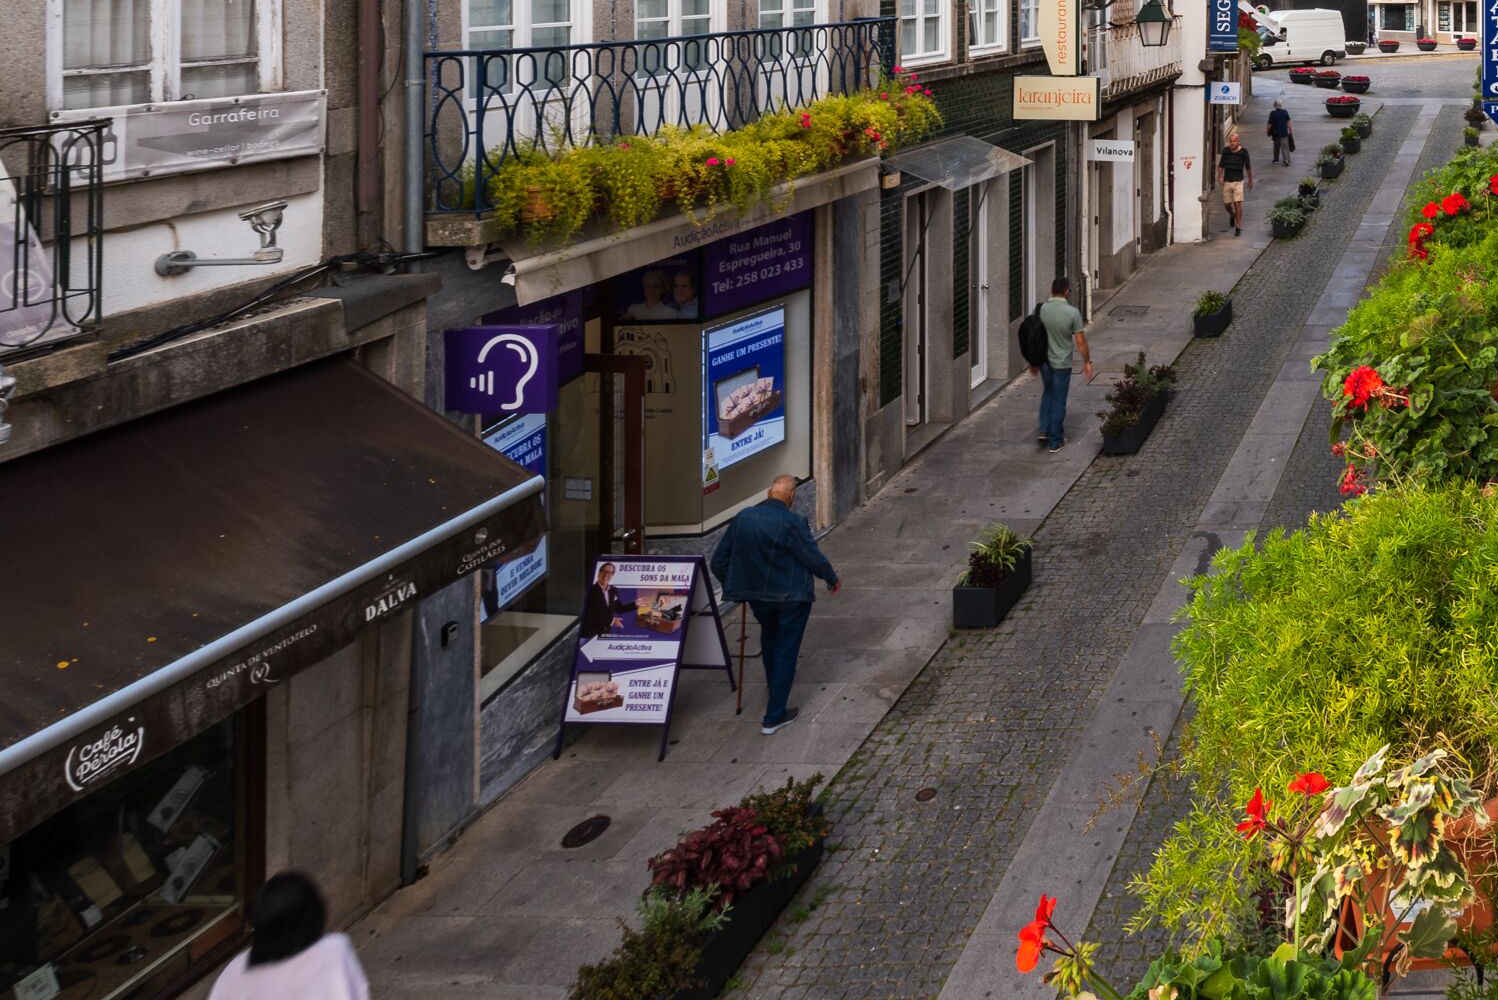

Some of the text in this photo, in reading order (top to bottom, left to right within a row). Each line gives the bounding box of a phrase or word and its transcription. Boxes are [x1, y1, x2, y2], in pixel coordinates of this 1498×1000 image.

[188, 107, 281, 127] Garrafeira
[1096, 146, 1134, 156] Vilanova
[729, 228, 793, 255] Rua Manuel
[718, 240, 802, 273] Espregueira, 30
[711, 258, 805, 295] Tel: 258 023 433
[711, 334, 783, 367] GANHE UM PRESENTE!
[731, 436, 753, 452] ENTRE
[753, 428, 766, 442] JÁ!
[525, 446, 543, 466] MALA
[619, 564, 668, 573] DESCUBRA OS
[640, 574, 690, 584] SONS DA MALA
[365, 581, 418, 622] DALVA
[206, 624, 318, 689] QUINTA DE VENTOZELO
[629, 677, 669, 688] ENTRE JÁ E
[629, 691, 664, 700] GANHE UM
[625, 703, 664, 712] PRESENTE!
[79, 724, 124, 762] Café
